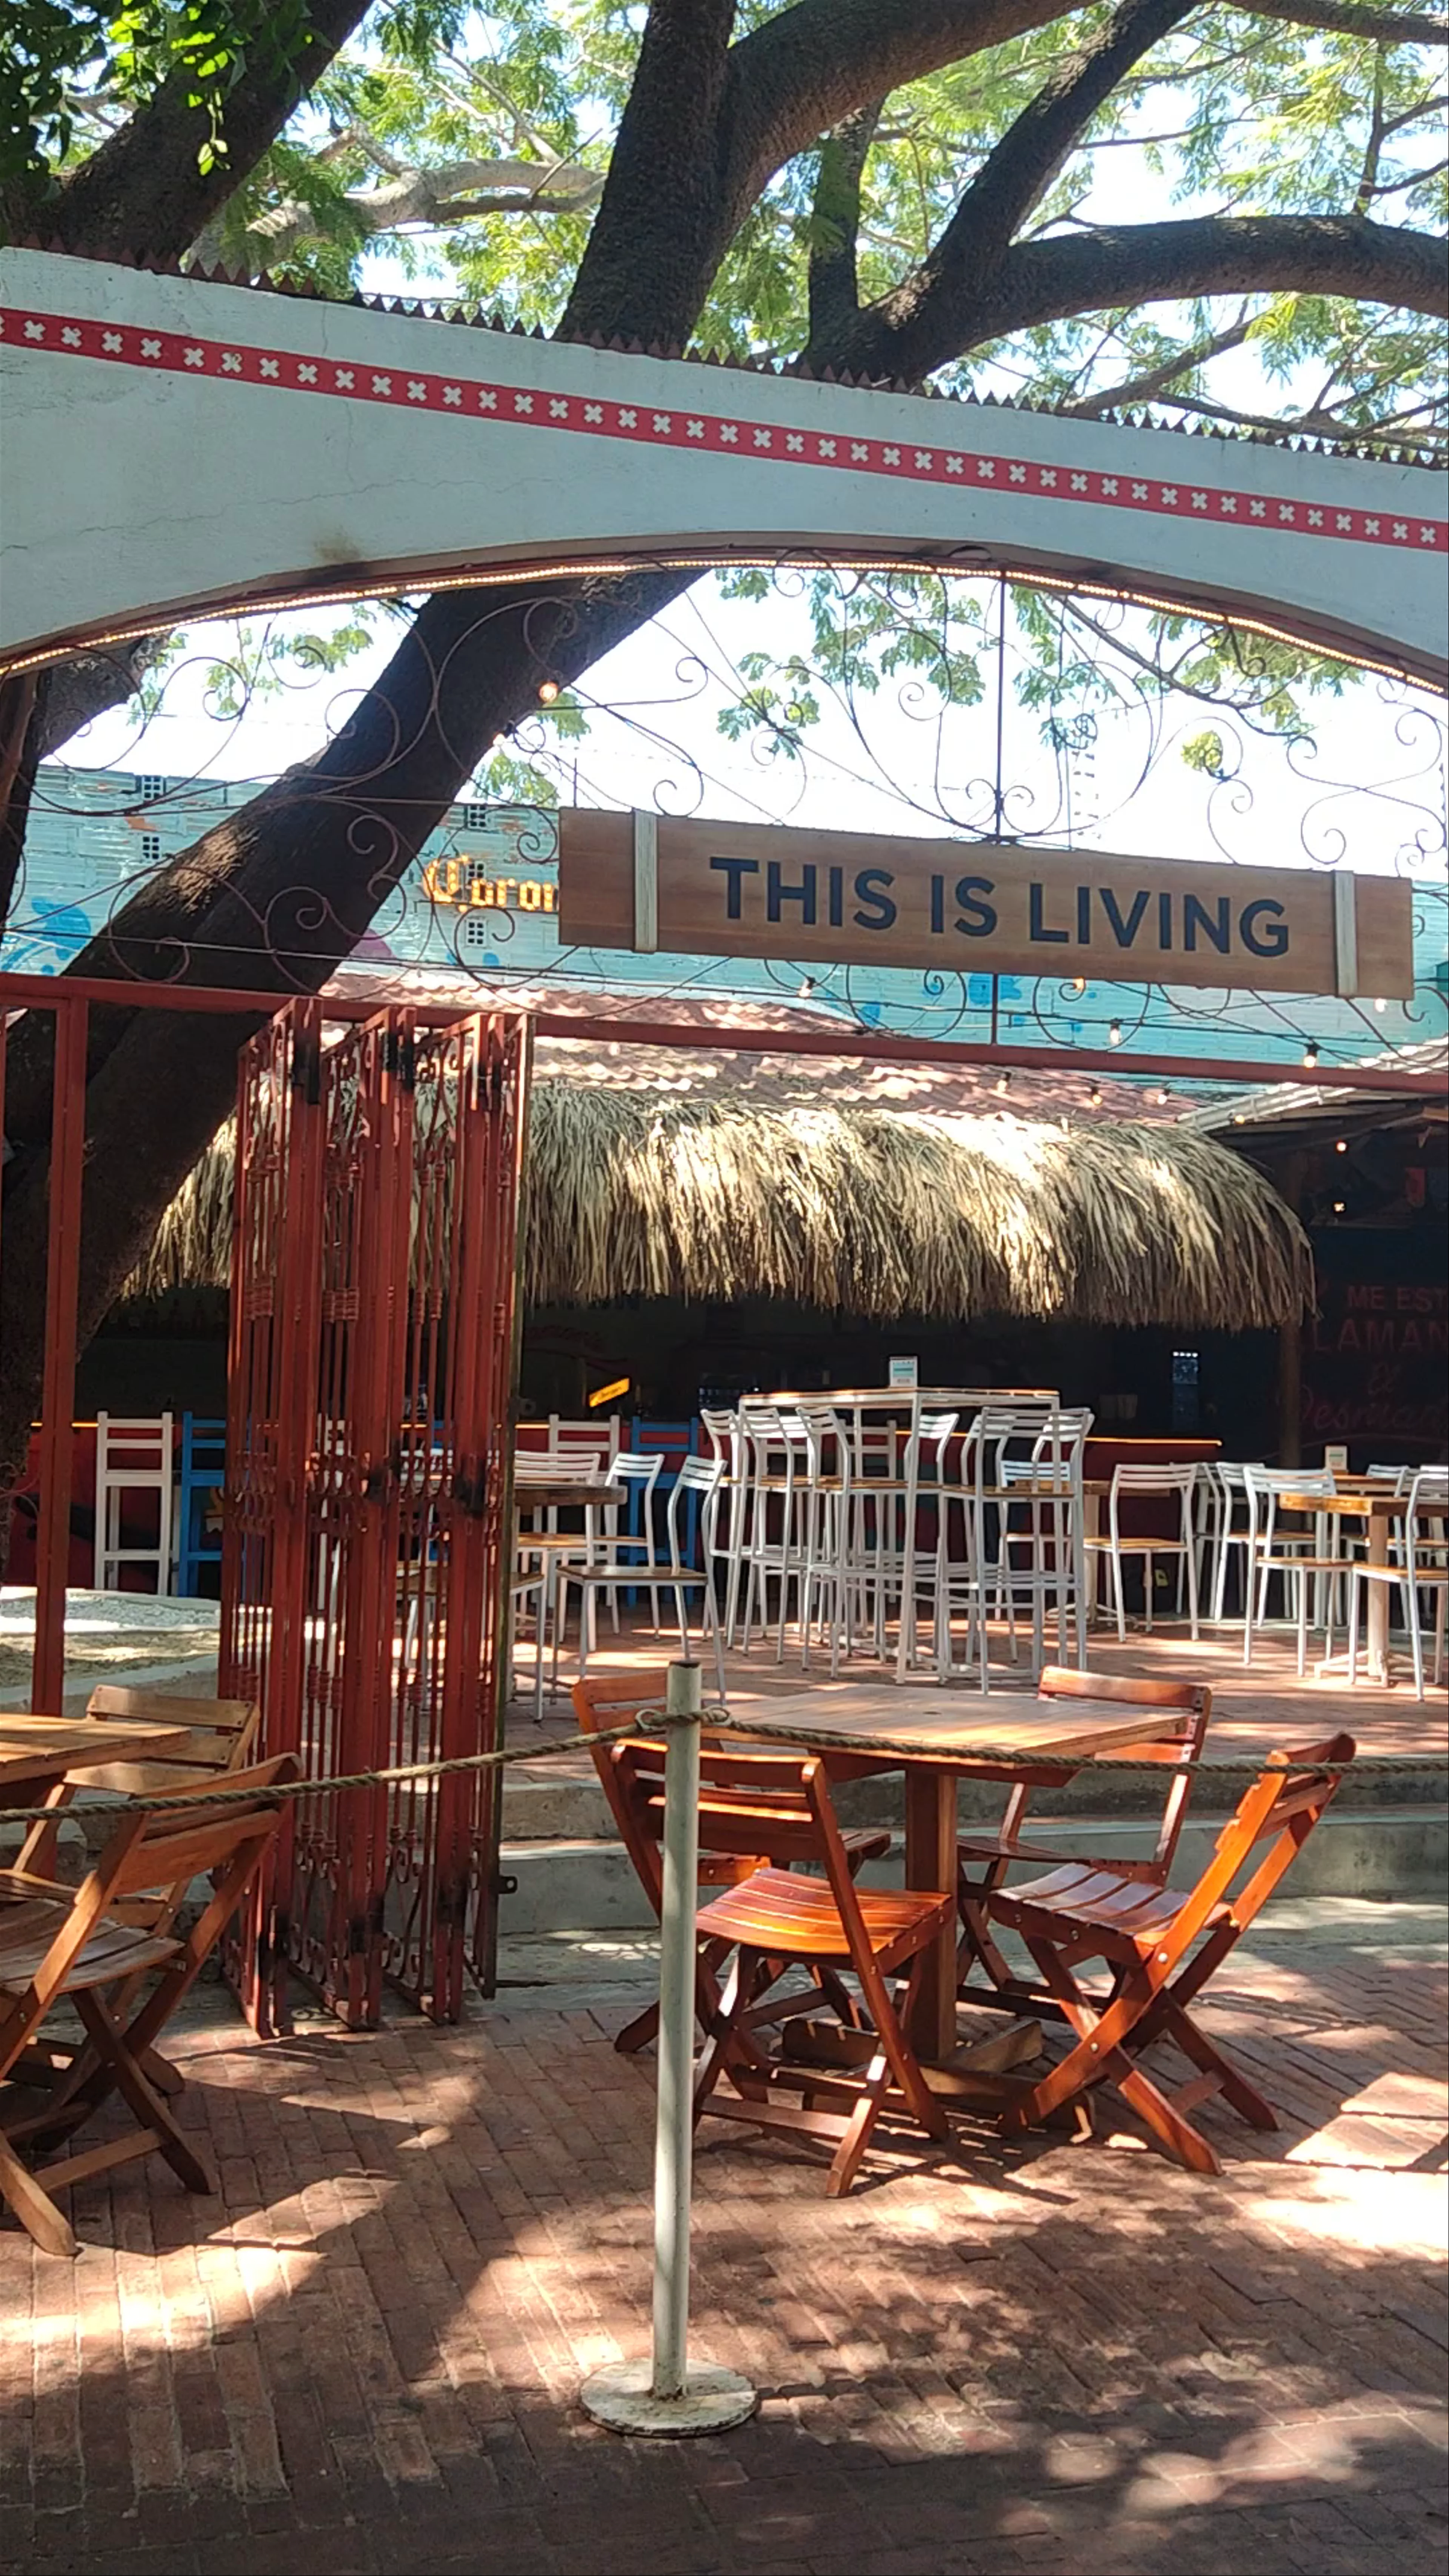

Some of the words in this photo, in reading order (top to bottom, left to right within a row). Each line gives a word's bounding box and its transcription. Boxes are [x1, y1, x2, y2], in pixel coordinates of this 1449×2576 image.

[710, 857, 897, 929] THIS
[931, 874, 998, 937] IS
[1029, 883, 1289, 956] LIVING
[1346, 1285, 1385, 1310] ME
